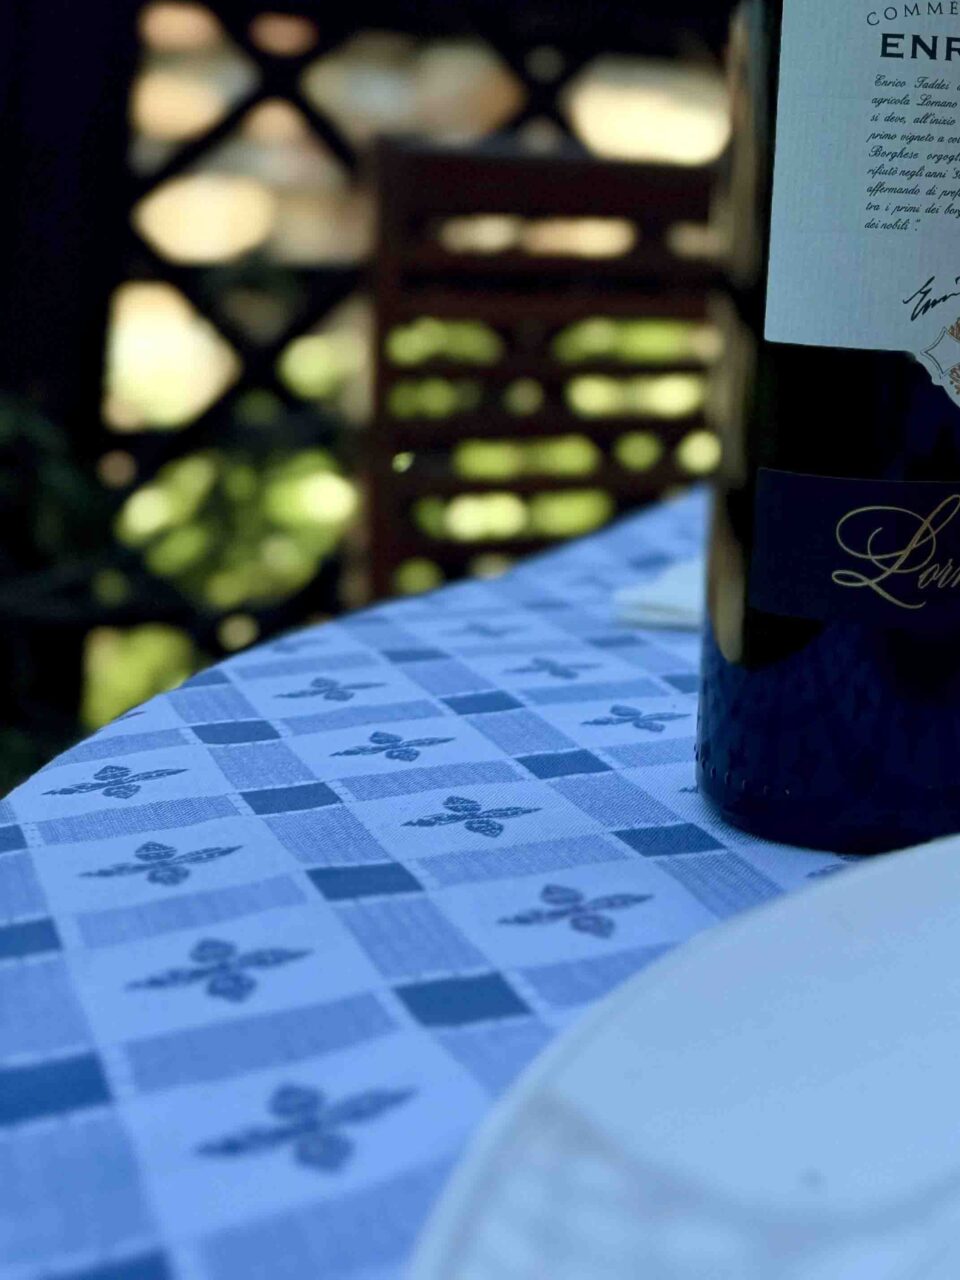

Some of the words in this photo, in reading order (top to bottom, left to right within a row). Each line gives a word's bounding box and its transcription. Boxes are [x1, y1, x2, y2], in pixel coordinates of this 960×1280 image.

[874, 73, 907, 88] Enrico
[871, 93, 911, 108] agricola
[870, 112, 881, 122] si
[866, 131, 898, 143] primo
[900, 132, 935, 145] vigneto
[937, 135, 945, 143] a
[868, 145, 920, 162] Borghese
[898, 165, 926, 181] negli
[924, 169, 949, 179] anni
[866, 181, 921, 197] affermando
[925, 184, 938, 196] di
[865, 201, 881, 212] tra
[891, 203, 922, 216] primi
[924, 203, 942, 214] dei
[864, 218, 881, 229] dei
